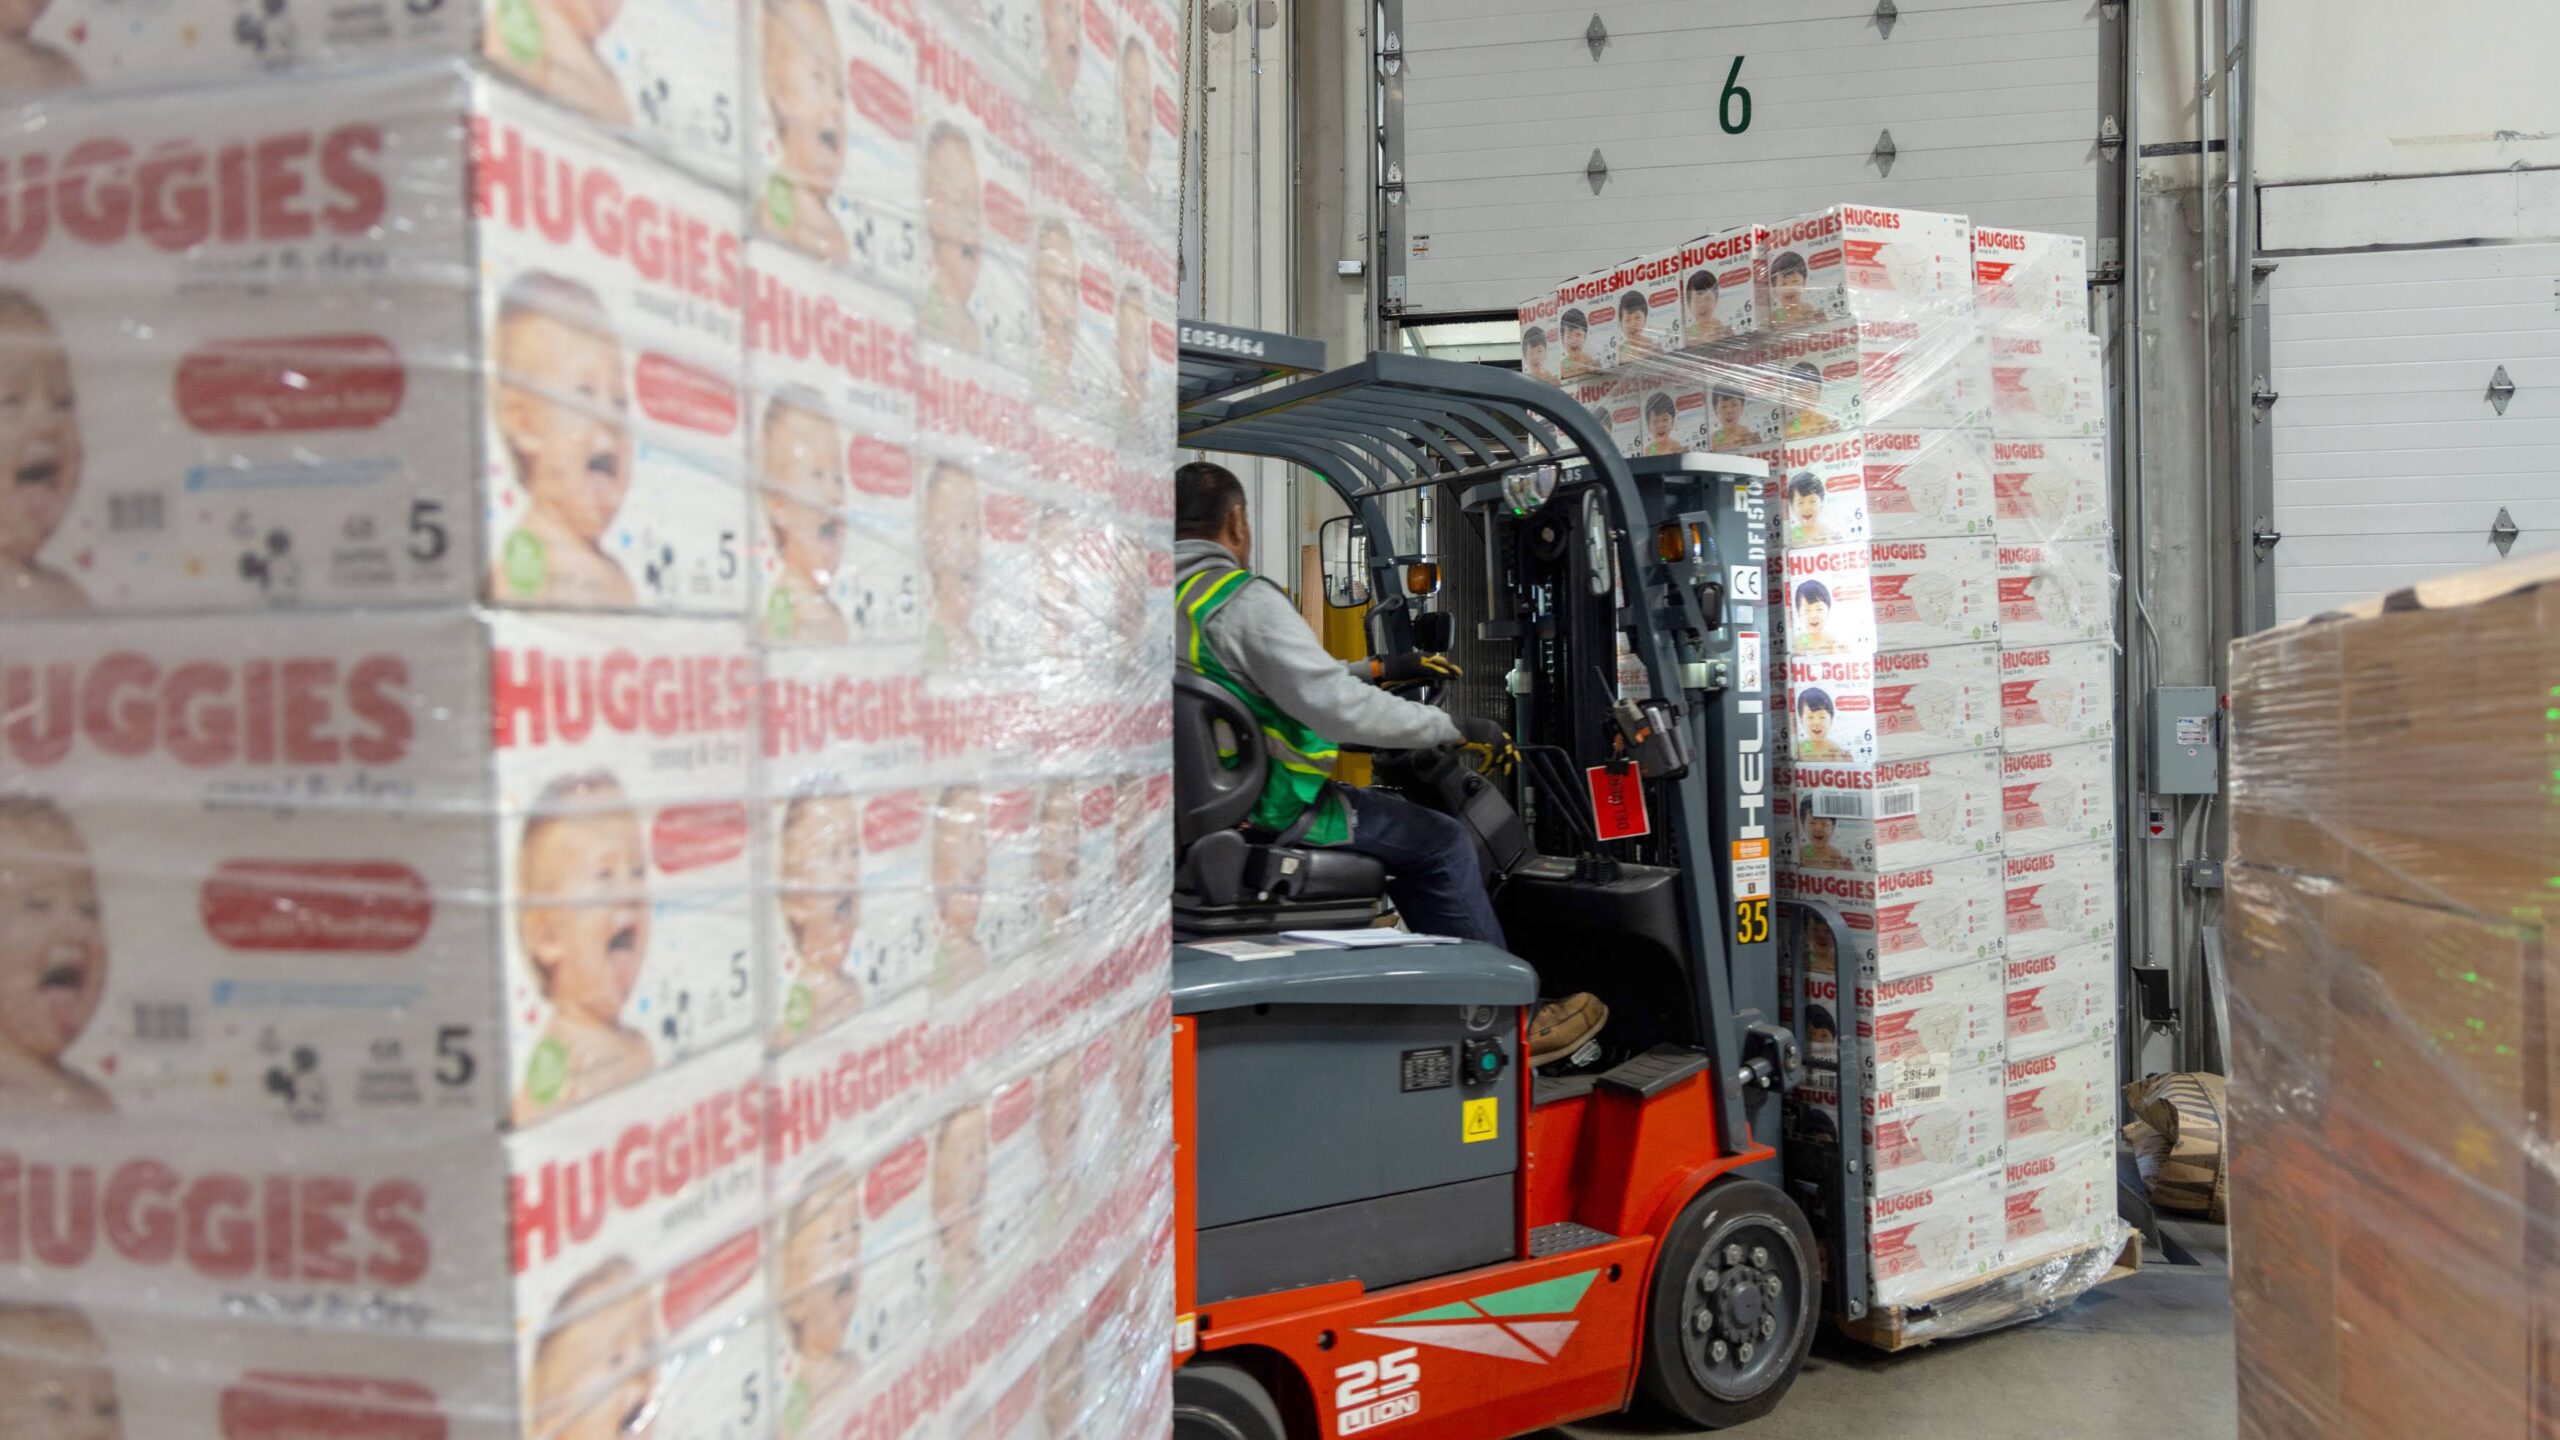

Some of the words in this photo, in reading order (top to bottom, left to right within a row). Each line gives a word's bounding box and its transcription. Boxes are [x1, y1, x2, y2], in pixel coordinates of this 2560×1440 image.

[1719, 56, 1751, 134] 6
[464, 113, 742, 308] HUGGIES
[1844, 207, 1900, 230] HUGGIES
[1763, 212, 1842, 250] HUGGIES
[1978, 230, 2026, 250] HUGGIES
[1682, 233, 1752, 270] HUGGIES
[1615, 255, 1680, 290] HUGGIES
[1557, 274, 1617, 307] HUGGIES
[1781, 325, 1860, 359] HUGGIES
[1782, 438, 1862, 469] HUGGIES
[1864, 433, 1921, 451] HUGGIES
[1994, 443, 2045, 460] HUGGIES
[407, 500, 448, 563] 5
[717, 530, 737, 580] 5
[1871, 543, 1927, 562] HUGGIES
[1874, 652, 1930, 673] HUGGIES
[2002, 650, 2050, 670] HUGGIES
[492, 645, 752, 748] HUGGIES
[762, 674, 924, 758] HUGGIES
[1738, 700, 1765, 839] HELI
[1794, 768, 1873, 790] HUGGIES
[1876, 760, 1931, 783] HUGGIES
[2004, 754, 2052, 774] HUGGIES
[1878, 869, 1934, 893] HUGGIES
[2006, 854, 2055, 876] HUGGIES
[1799, 874, 1876, 900] HUGGIES
[1737, 901, 1768, 944] 35
[729, 950, 747, 998] 5
[2008, 954, 2056, 980] HUGGIES
[1877, 976, 1934, 1001] HUGGIES
[435, 1026, 476, 1087] 5
[2008, 1055, 2056, 1082] HUGGIES
[763, 1022, 929, 1165] HUGGIES
[506, 1075, 764, 1276] HUGGIES
[2006, 1156, 2056, 1183] HUGGIES
[1876, 1189, 1933, 1219] HUGGIES
[1335, 1347, 1420, 1408] 25
[739, 1370, 758, 1426] 5
